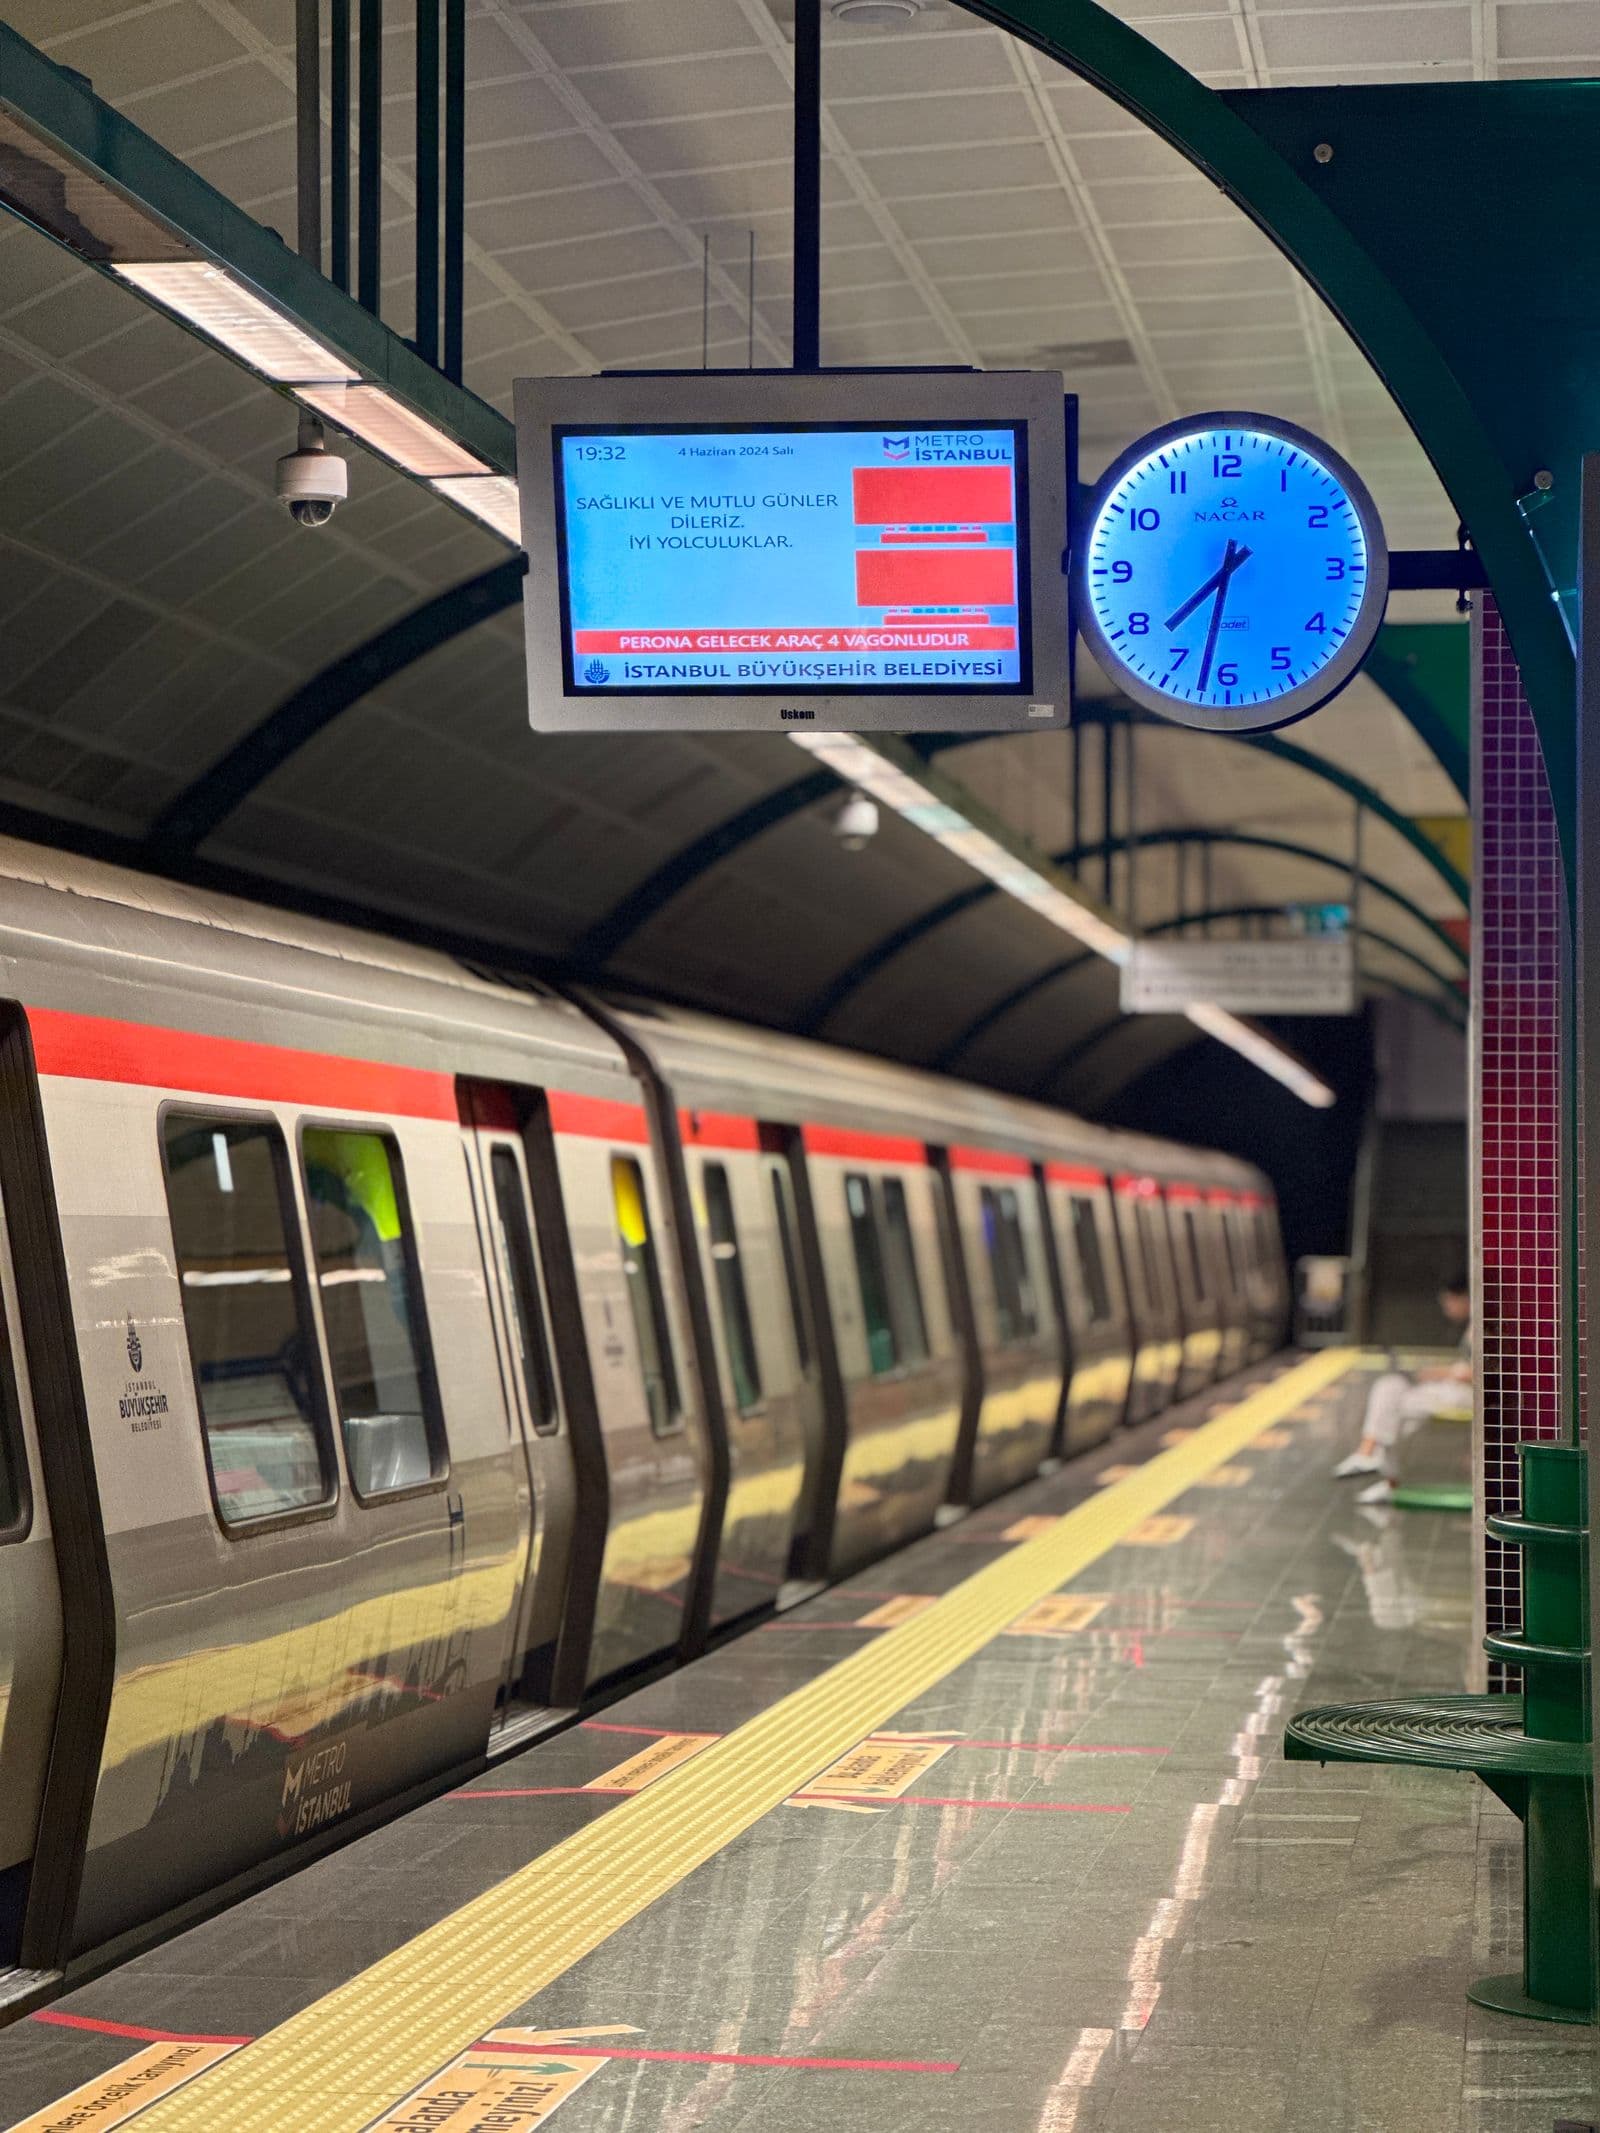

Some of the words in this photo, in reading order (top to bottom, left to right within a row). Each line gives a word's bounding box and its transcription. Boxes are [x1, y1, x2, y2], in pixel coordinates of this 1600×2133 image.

[678, 448, 686, 457] 4
[689, 447, 736, 457] Haziran
[738, 446, 769, 456] 2024
[772, 446, 794, 456] Salı
[915, 434, 984, 447] METRO
[575, 446, 626, 461] 19:32
[915, 447, 1012, 461] İSTANBUL
[1212, 454, 1242, 478] 12
[1169, 470, 1187, 494] 11
[1280, 469, 1287, 492] 1
[576, 494, 655, 510] SAĞLIKLI
[660, 496, 686, 509] VE
[691, 495, 756, 509] MUTLU
[762, 492, 839, 508] GÜNLER
[671, 515, 745, 529] DİLERİZ.
[1130, 508, 1161, 531] 10
[1193, 510, 1266, 522] NACAR
[1308, 505, 1329, 529] 2
[629, 534, 651, 550] İYİ
[656, 535, 793, 550] YOLCULUKLAR.
[1111, 560, 1133, 584] 9
[1325, 557, 1345, 581] 3
[1128, 612, 1150, 635] 8
[1304, 611, 1327, 635] 4
[619, 635, 692, 649] PERONA
[696, 635, 772, 649] GELECEK
[775, 634, 823, 650] ARAÇ
[827, 634, 839, 647] 4
[843, 633, 970, 648] VAGONLUDUR
[624, 661, 731, 679] İSTANBUL
[738, 660, 877, 679] BÜYÜKŞEHİR
[884, 658, 1003, 676] BELEDİYESİ
[1169, 648, 1190, 672] 7
[1270, 647, 1292, 671] 5
[1217, 663, 1239, 687] 6
[119, 1389, 169, 1421] BÜYÜKŞEHİR
[303, 1741, 347, 1788] METRO
[387, 2090, 478, 2133] alanda
